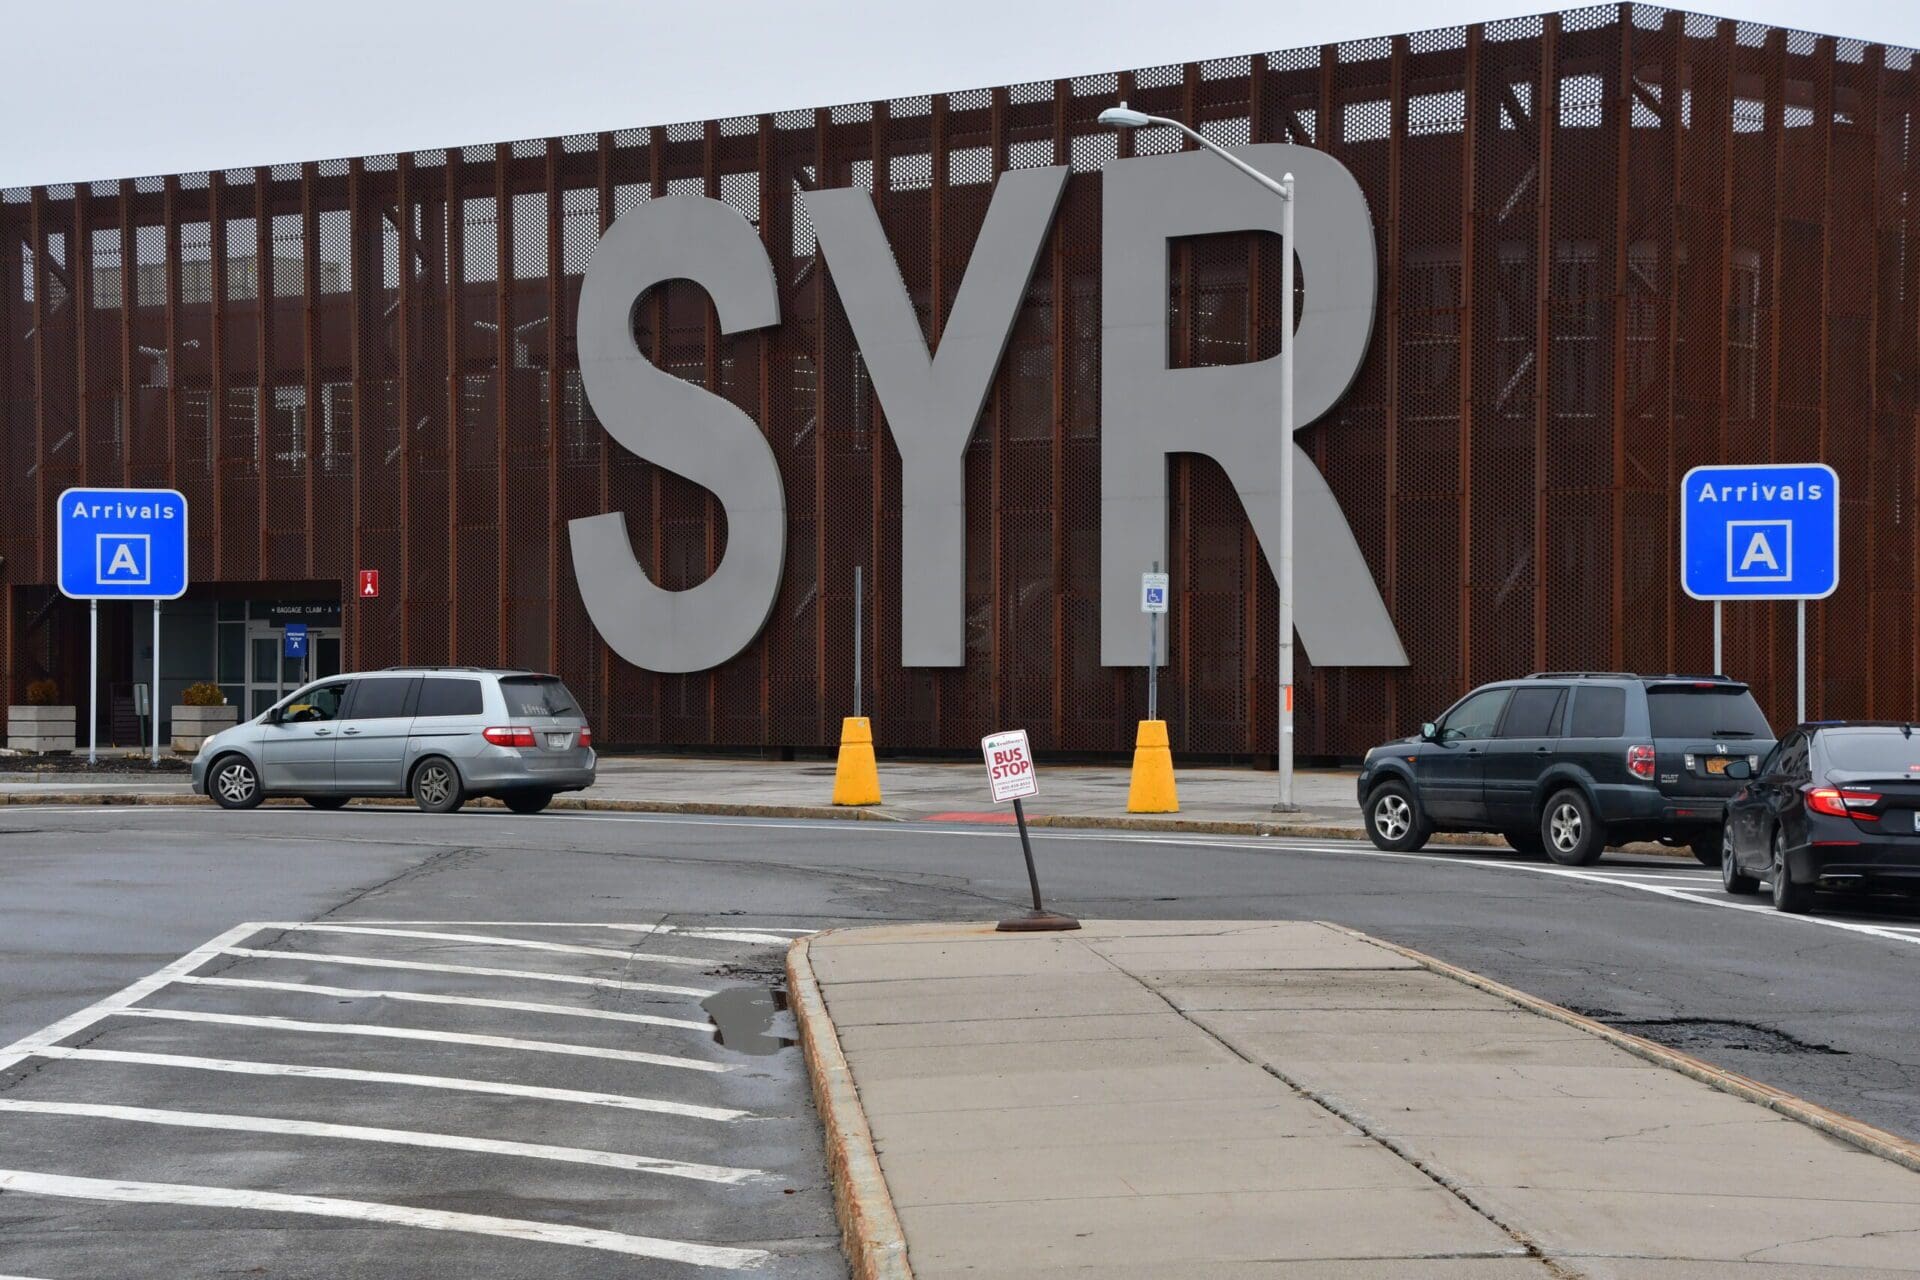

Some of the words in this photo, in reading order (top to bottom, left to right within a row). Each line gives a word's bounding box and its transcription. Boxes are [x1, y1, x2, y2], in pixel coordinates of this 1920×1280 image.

[568, 143, 1410, 673] SYR
[1698, 481, 1822, 502] Arrivals
[72, 502, 175, 519] Arrivals
[107, 543, 140, 575] A
[1740, 532, 1779, 570] A
[994, 747, 1023, 765] BUS
[992, 761, 1029, 780] STOP
